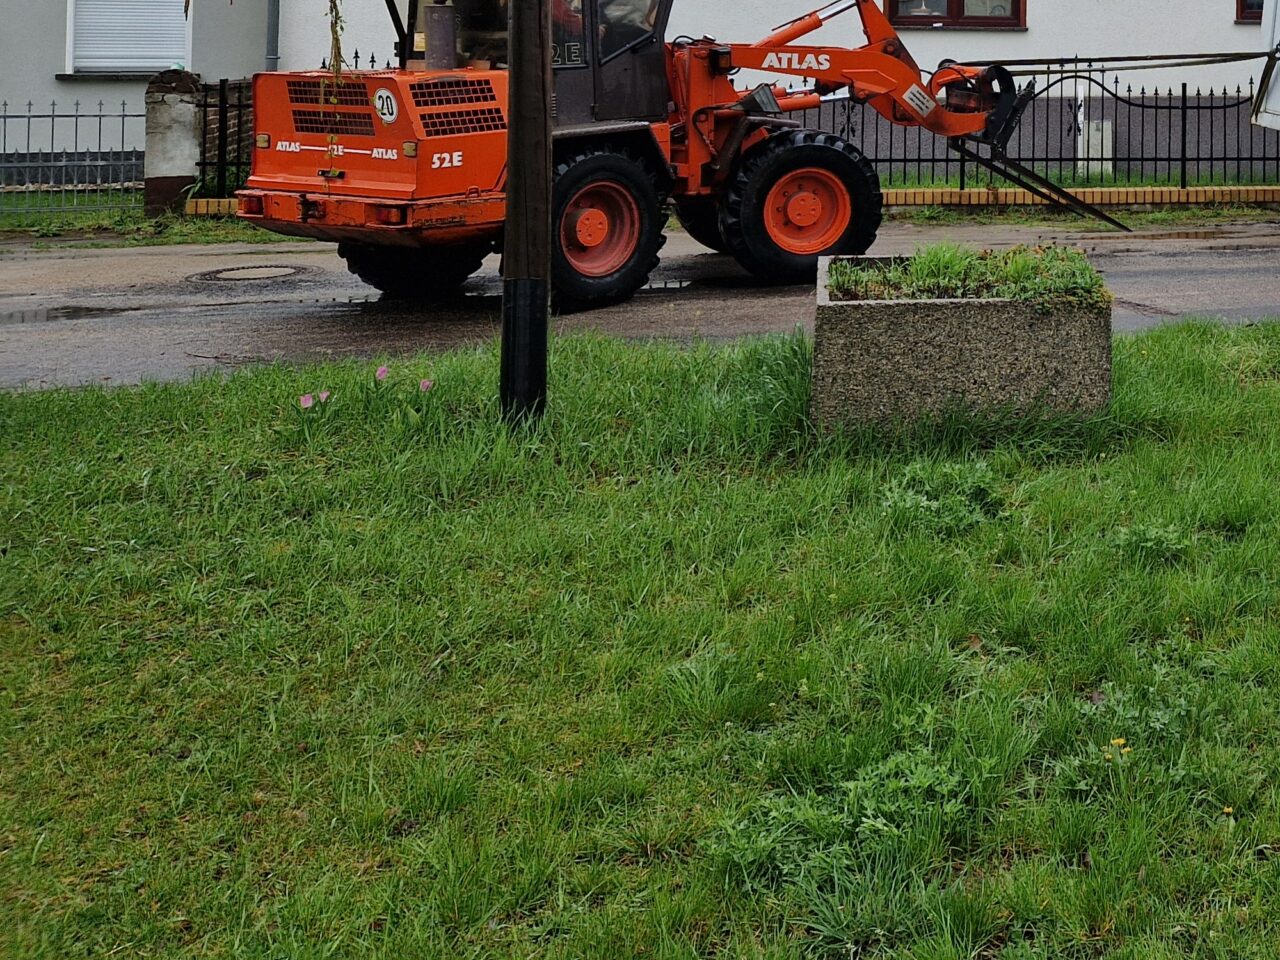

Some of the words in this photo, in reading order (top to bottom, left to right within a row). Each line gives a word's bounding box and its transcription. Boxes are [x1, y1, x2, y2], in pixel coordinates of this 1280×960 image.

[761, 52, 831, 71] ATLAS
[377, 94, 394, 117] 20
[276, 141, 301, 152] ATLAS
[371, 147, 398, 160] ATLAS
[431, 151, 464, 169] 52E
